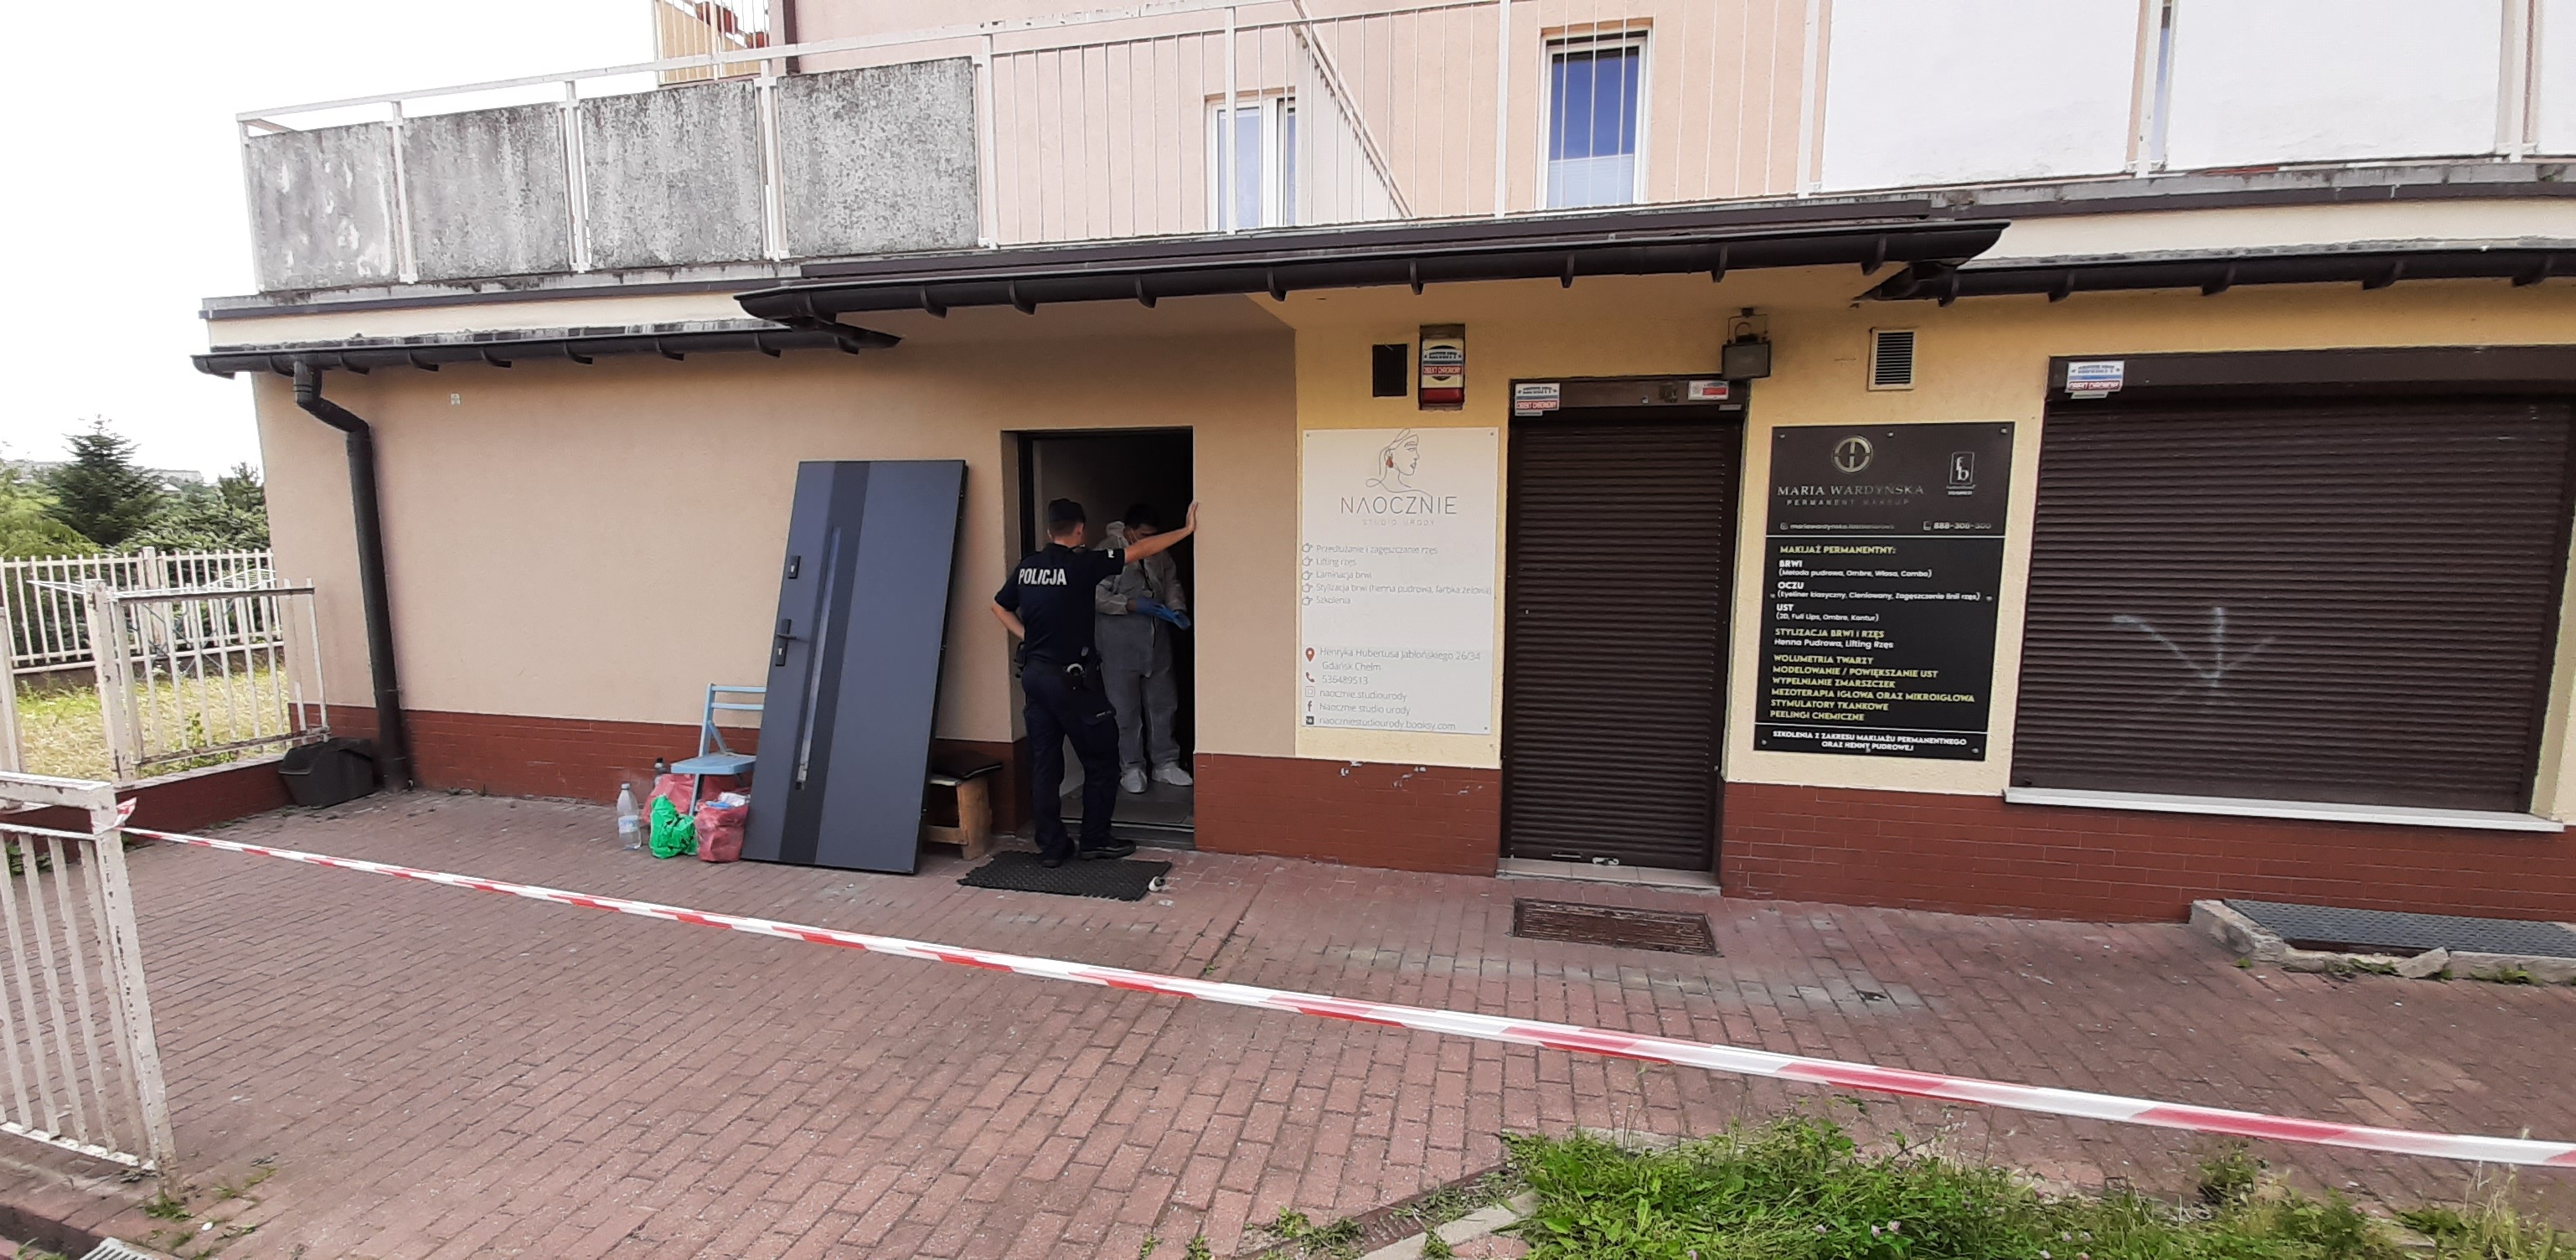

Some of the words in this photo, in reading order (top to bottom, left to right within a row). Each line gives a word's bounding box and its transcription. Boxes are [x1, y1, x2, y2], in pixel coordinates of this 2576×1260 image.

[1777, 485, 1825, 496] MARIA
[1830, 483, 1924, 496] WARDYŃSKA
[1341, 496, 1458, 514] NAOCZNIE
[1779, 545, 1821, 554] MAKIJAŻ
[1823, 545, 1897, 554] PERMANENTNY:
[1018, 567, 1067, 586] POLICJA
[1778, 568, 1809, 576] (Metoda
[1901, 569, 1933, 578] Combo)
[1776, 603, 1794, 612] UST
[1851, 613, 1879, 622] Kontur)
[1775, 628, 1828, 637] STYLIZACJA
[1830, 629, 1854, 638] BRWI
[1861, 630, 1885, 639] RZĘS
[1804, 639, 1843, 648] Pudrowa,
[1845, 640, 1871, 649] Lifting
[1773, 654, 1834, 664] WOLUMETRIA
[1836, 656, 1874, 664] TWARZY
[1773, 666, 1840, 675] MODELOWANIE
[1849, 669, 1918, 679] POWIĘKSZANIE
[1835, 679, 1896, 688] ZMARSZCZEK
[1771, 689, 1835, 698] MEZOTERAPIA
[1877, 692, 1903, 700] ORAZ
[1771, 700, 1835, 709] STYMULATORY
[1837, 702, 1889, 710] TKANKOWE
[1769, 710, 1809, 719] PEELINGI
[1812, 712, 1865, 720] CHEMICZNE
[1773, 731, 1813, 739] SZKOLENIA
[1821, 732, 1855, 741] ZAKRESU
[1856, 734, 1895, 742] MAKIJAŻU
[1897, 736, 1967, 746] PERMANENTNEGO
[1871, 743, 1914, 751] PUDROWEJ
